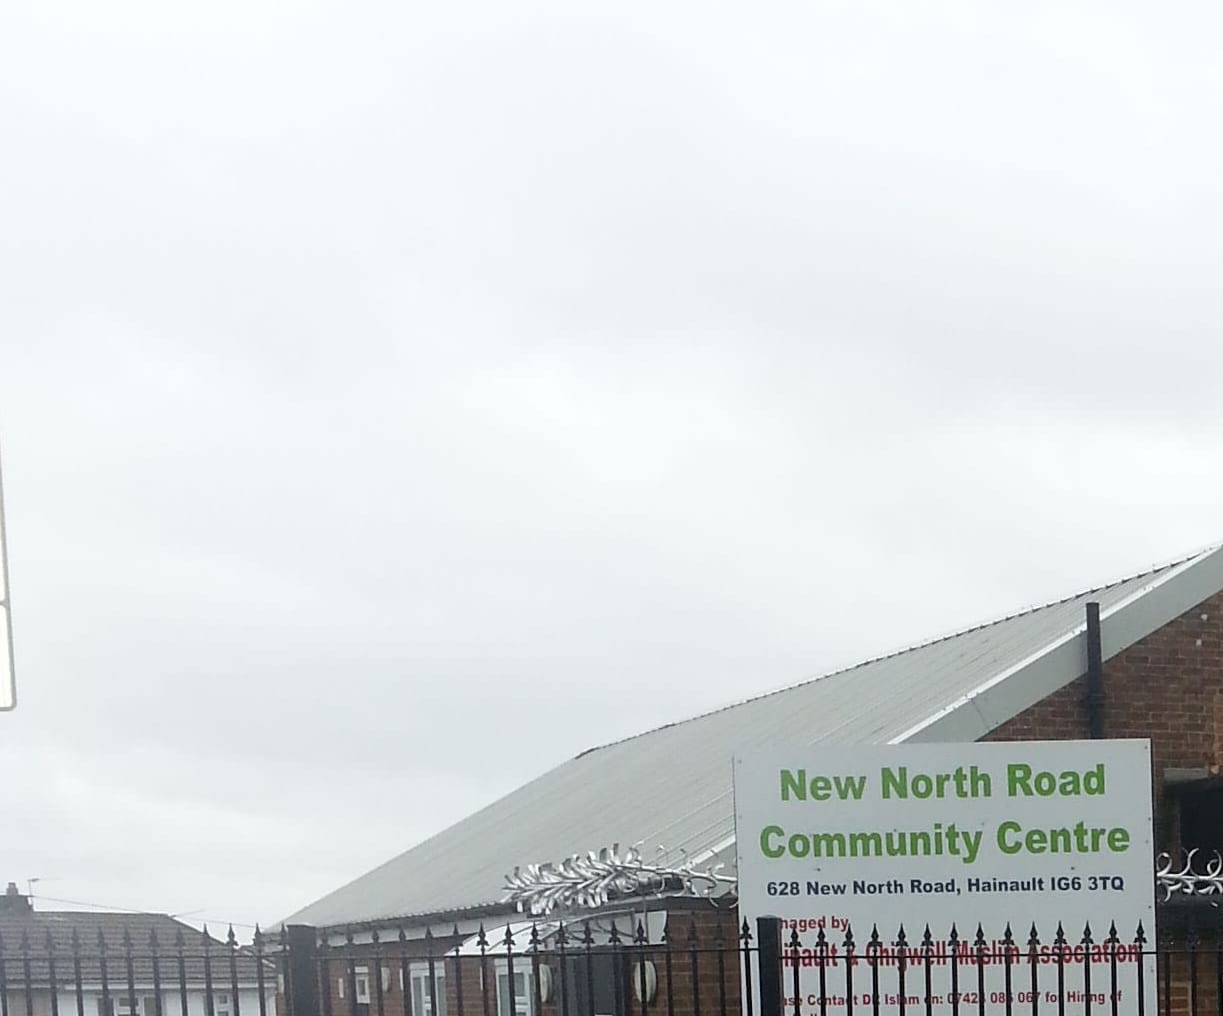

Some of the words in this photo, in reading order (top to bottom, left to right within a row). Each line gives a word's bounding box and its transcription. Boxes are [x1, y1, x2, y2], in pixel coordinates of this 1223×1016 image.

[780, 769, 867, 800] New
[881, 766, 992, 799] North
[1007, 764, 1106, 797] Road
[760, 823, 983, 864] Community
[996, 821, 1130, 854] Centre
[767, 881, 800, 896] 628
[806, 881, 847, 895] New
[853, 879, 904, 895] North
[910, 879, 961, 895] Road,
[967, 877, 1044, 892] Hainault
[1051, 876, 1082, 891] IG6
[1088, 876, 1124, 891] 3TQ
[781, 915, 826, 932] naged
[832, 915, 849, 932] by
[1045, 991, 1062, 1003] fo
